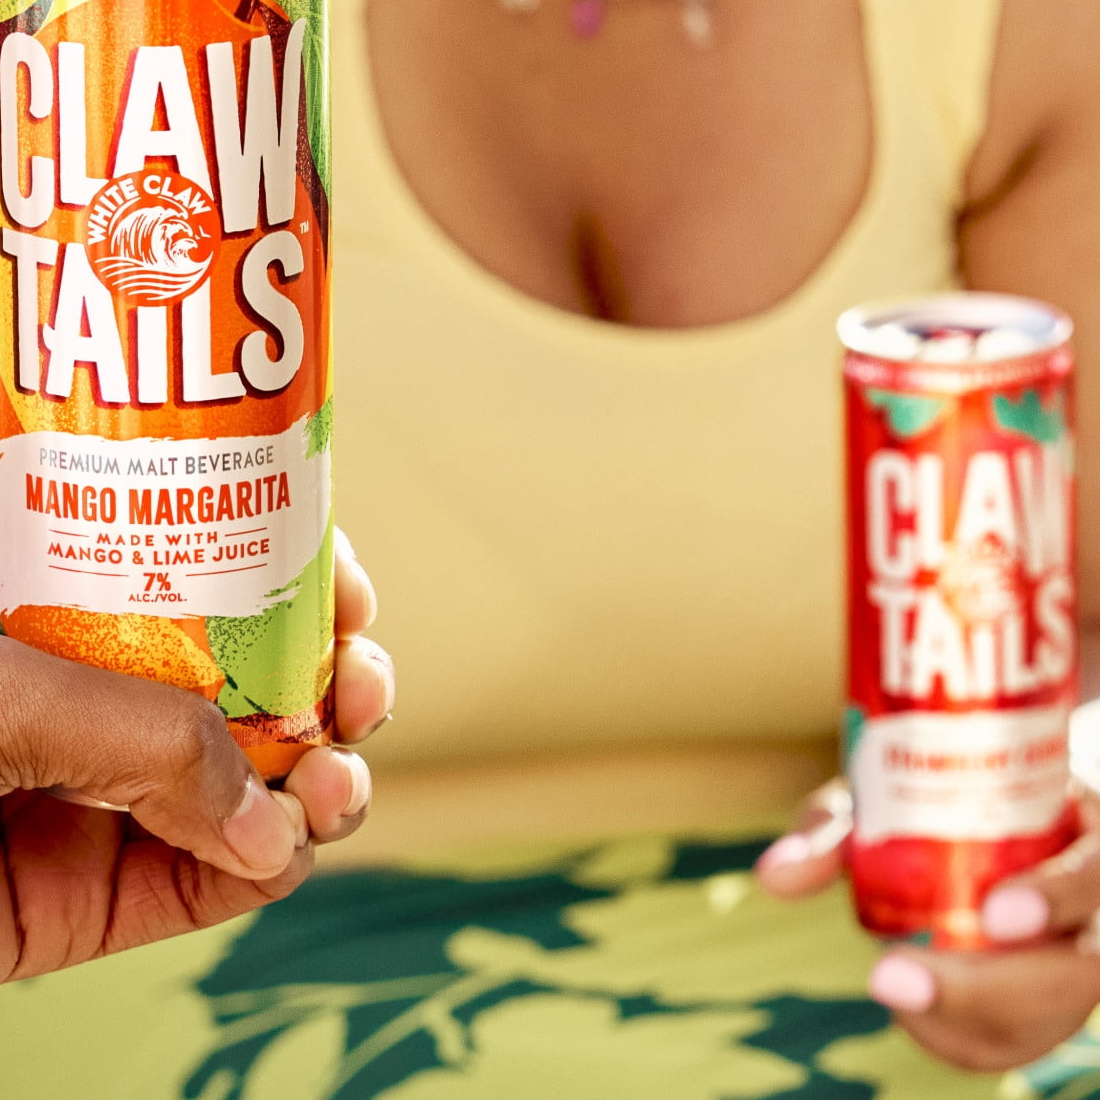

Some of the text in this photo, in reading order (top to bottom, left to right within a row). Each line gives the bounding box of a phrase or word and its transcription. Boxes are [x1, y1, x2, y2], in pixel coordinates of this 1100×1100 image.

[0, 18, 307, 234] CLAW
[87, 174, 213, 246] WHITE CLAW
[0, 227, 305, 404] TAILS
[39, 445, 274, 477] PREMIUM MALT BEVERAGE
[25, 471, 291, 527] MANGO MARGARITA
[47, 538, 270, 566] MANGO & LIME JUICE
[96, 531, 218, 547] MADE WITH
[128, 592, 188, 603] ALC./VOL.
[142, 572, 172, 592] 7%
